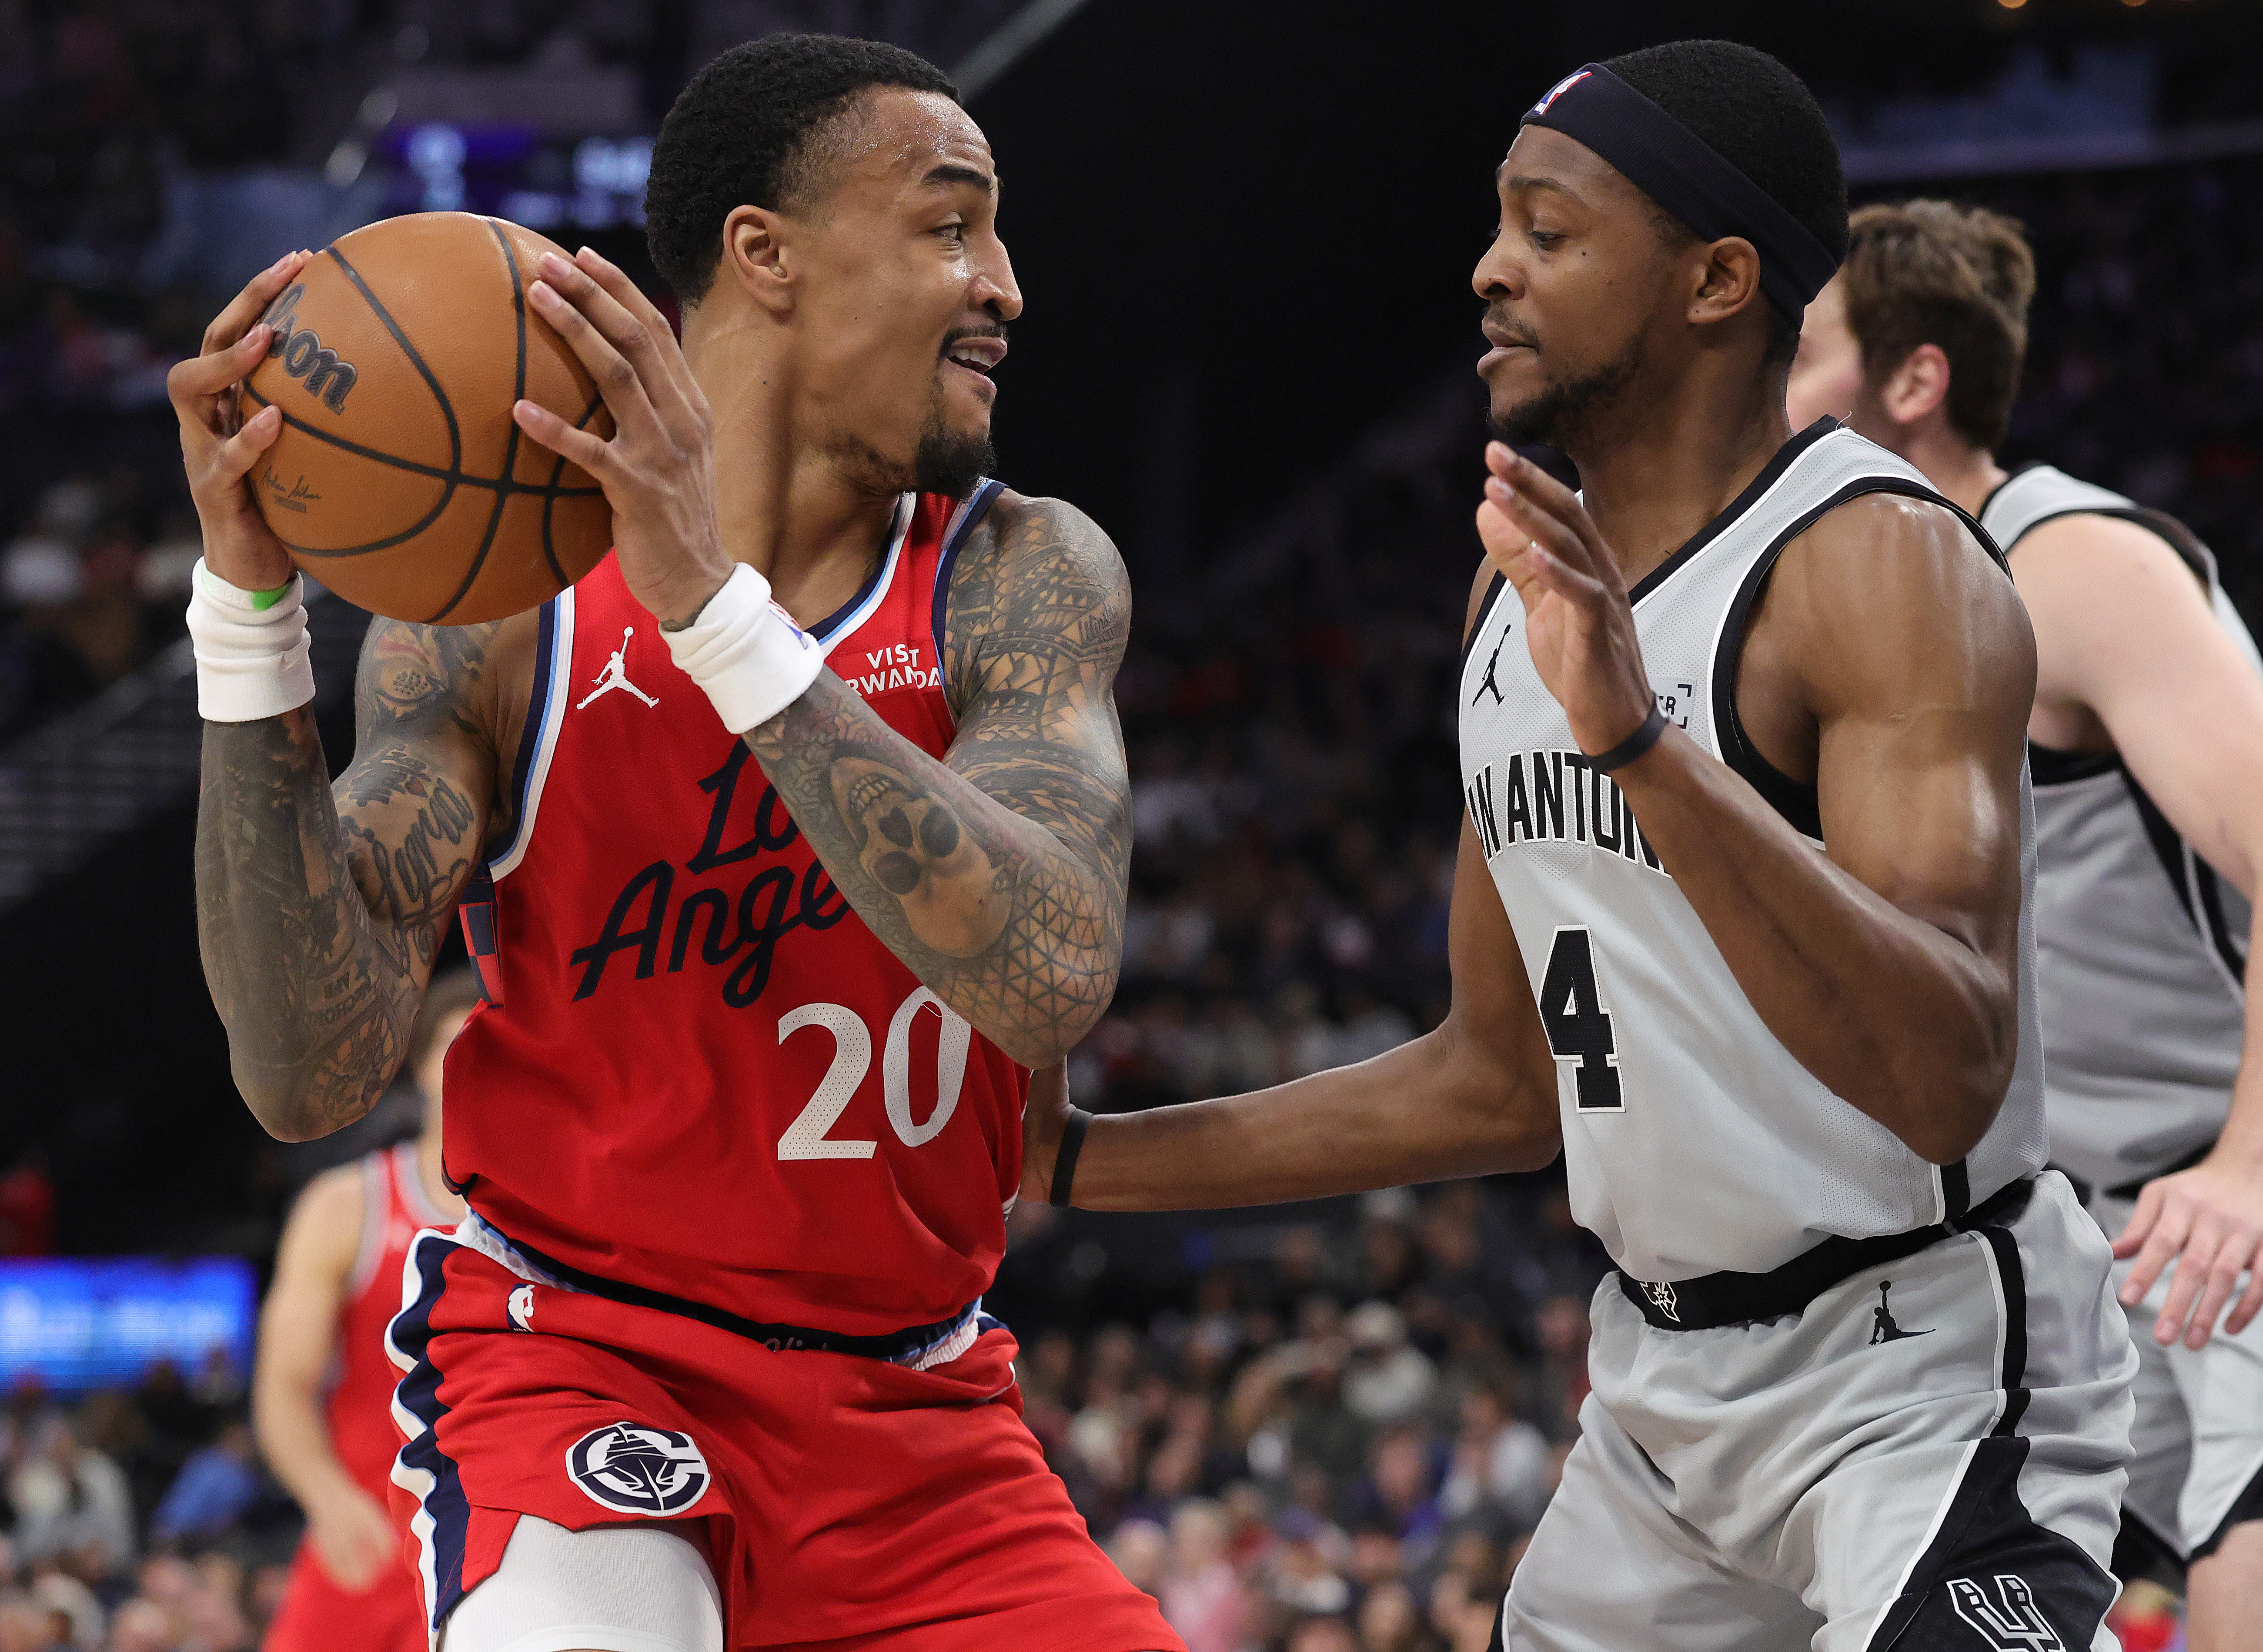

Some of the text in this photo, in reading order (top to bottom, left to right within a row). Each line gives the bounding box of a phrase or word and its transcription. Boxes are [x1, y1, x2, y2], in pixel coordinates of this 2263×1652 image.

[866, 644, 919, 669] VIST
[686, 737, 799, 875] Lo
[570, 859, 851, 1008] Ange
[778, 986, 971, 1160] 20
[1538, 924, 1626, 1113] 4
